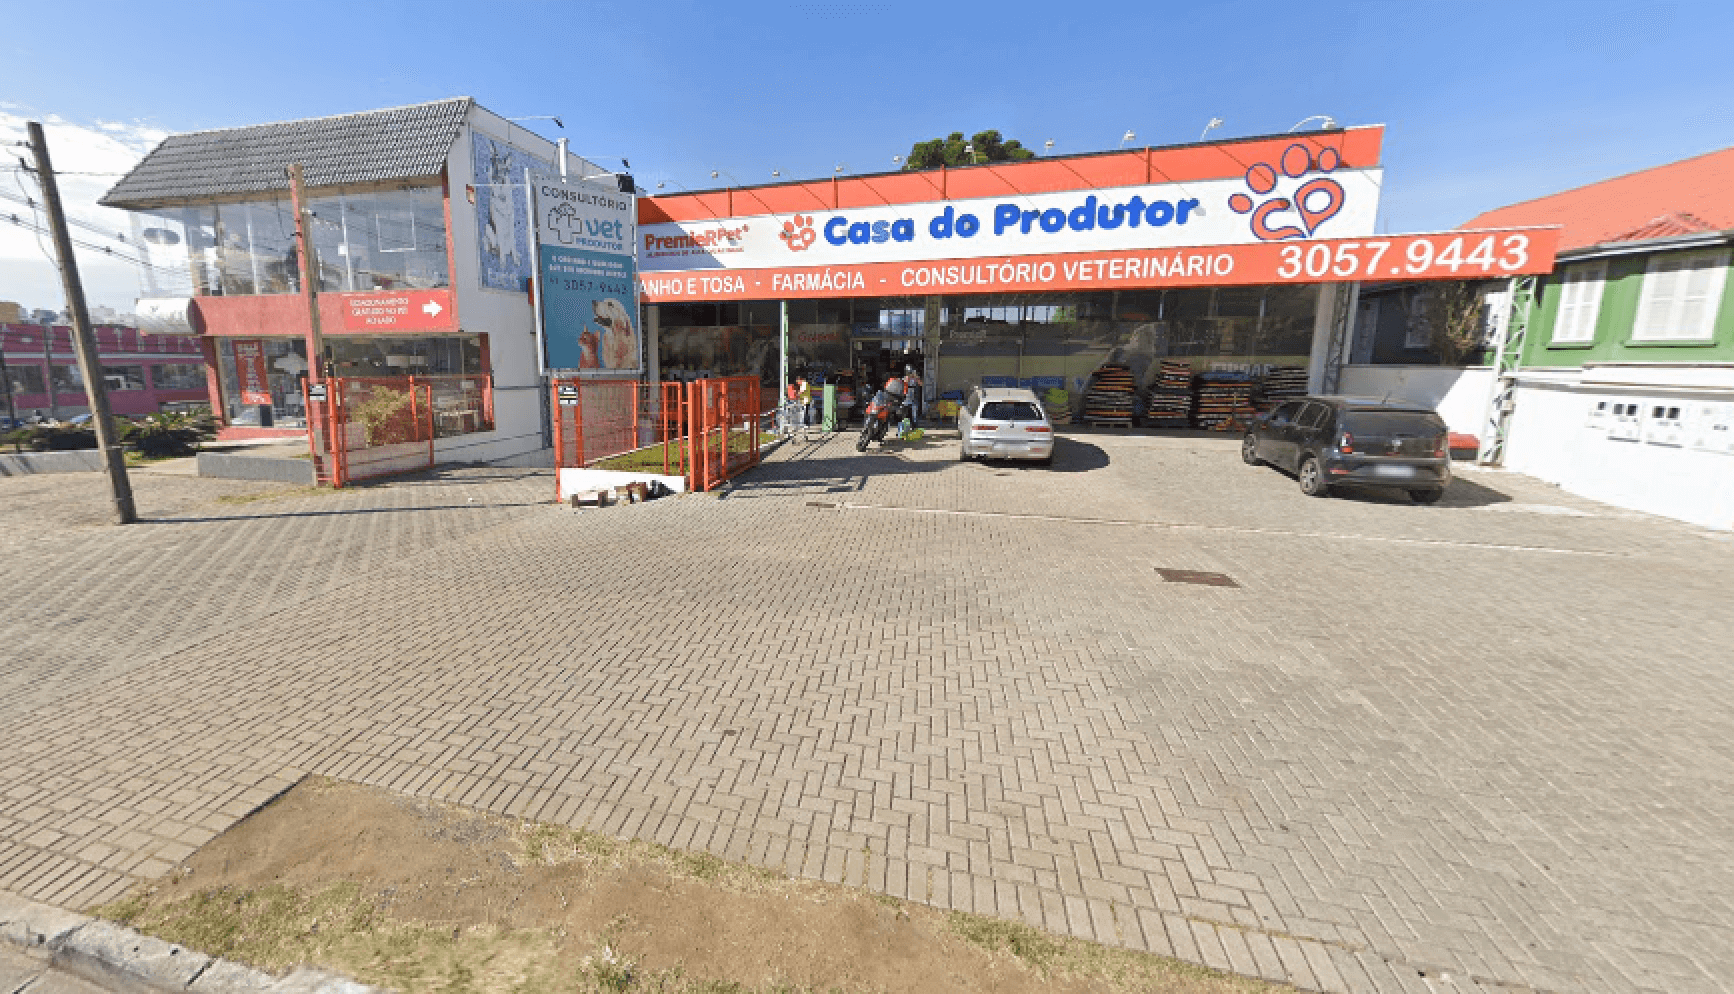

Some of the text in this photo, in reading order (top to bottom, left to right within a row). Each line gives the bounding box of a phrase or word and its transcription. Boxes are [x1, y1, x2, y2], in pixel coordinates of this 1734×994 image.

[542, 185, 627, 211] CONSULTÓRIO
[585, 218, 623, 241] vet
[823, 195, 1199, 247] Casa do Produtor
[639, 278, 683, 297] ANHO
[686, 277, 697, 295] E
[700, 275, 745, 294] TOSA
[771, 267, 865, 291] FARMÁCIA
[901, 260, 1057, 287] CONSULTÓRIO
[1063, 252, 1235, 281] VETERINÁRIO
[1277, 234, 1530, 278] 3057.9443
